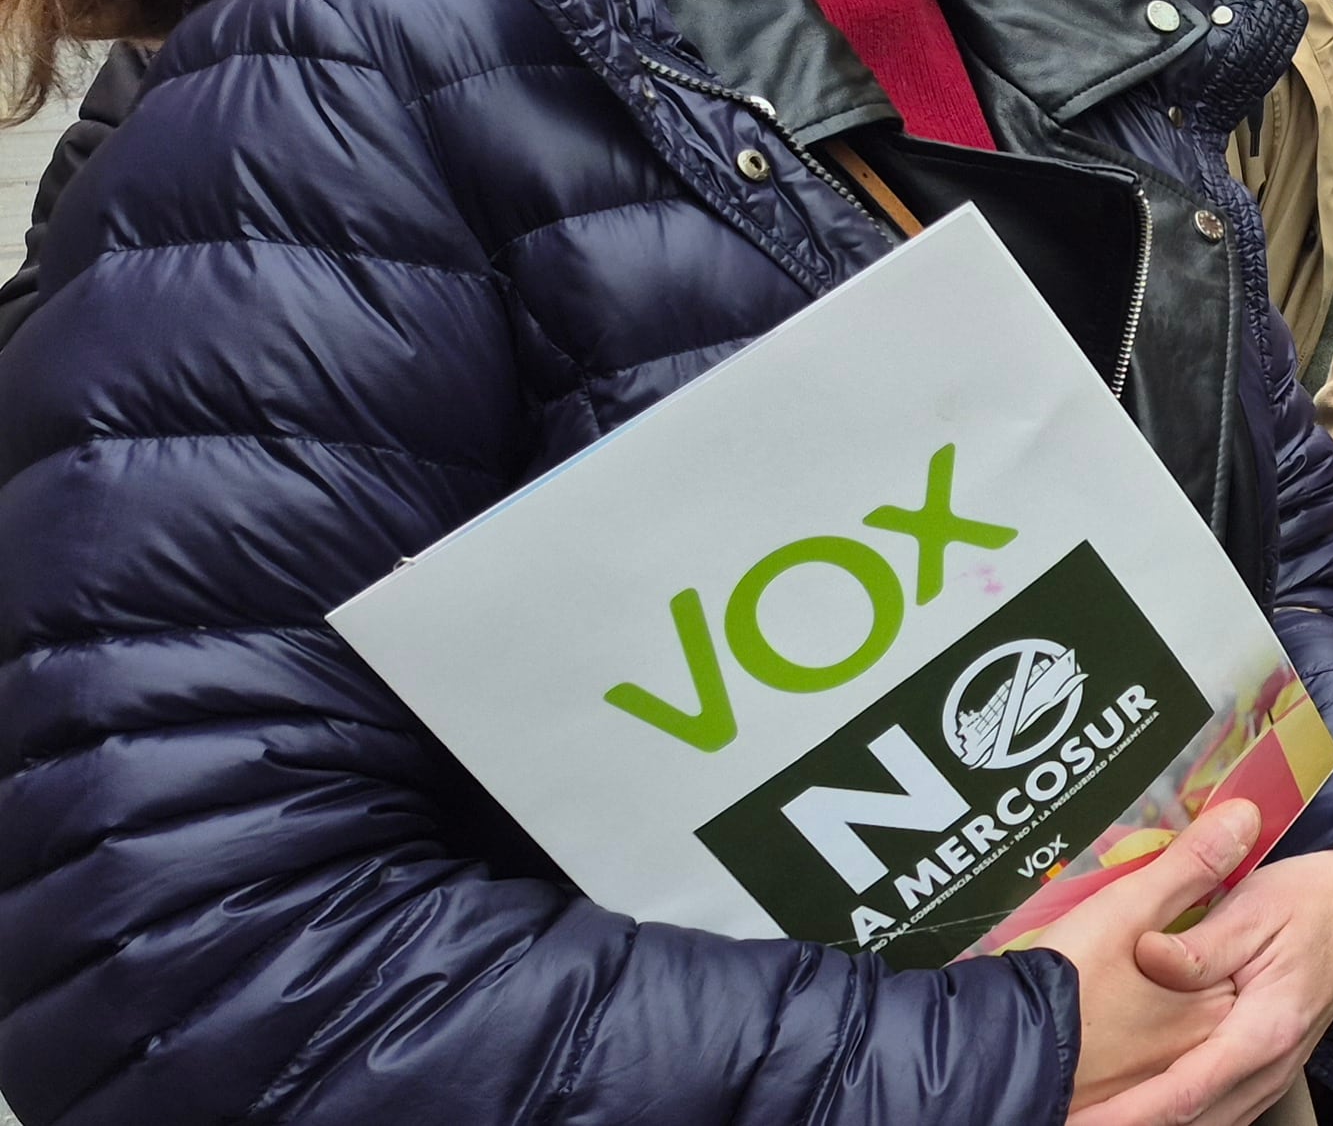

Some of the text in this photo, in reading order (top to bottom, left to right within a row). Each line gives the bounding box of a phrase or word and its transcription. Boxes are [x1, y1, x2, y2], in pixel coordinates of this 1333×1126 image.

[603, 442, 1019, 754] VOX
[850, 684, 1158, 948] A MERCOSUR
[910, 874, 973, 924] COMPETENCIA
[972, 844, 1010, 876] DESLEAL
[1014, 826, 1031, 841] NO
[1031, 819, 1040, 829] A
[1038, 809, 1052, 822] LA
[1051, 760, 1109, 811] INSEGURIDAD
[1108, 711, 1160, 762] ALIMENTARIA
[1017, 833, 1070, 879] VOX
